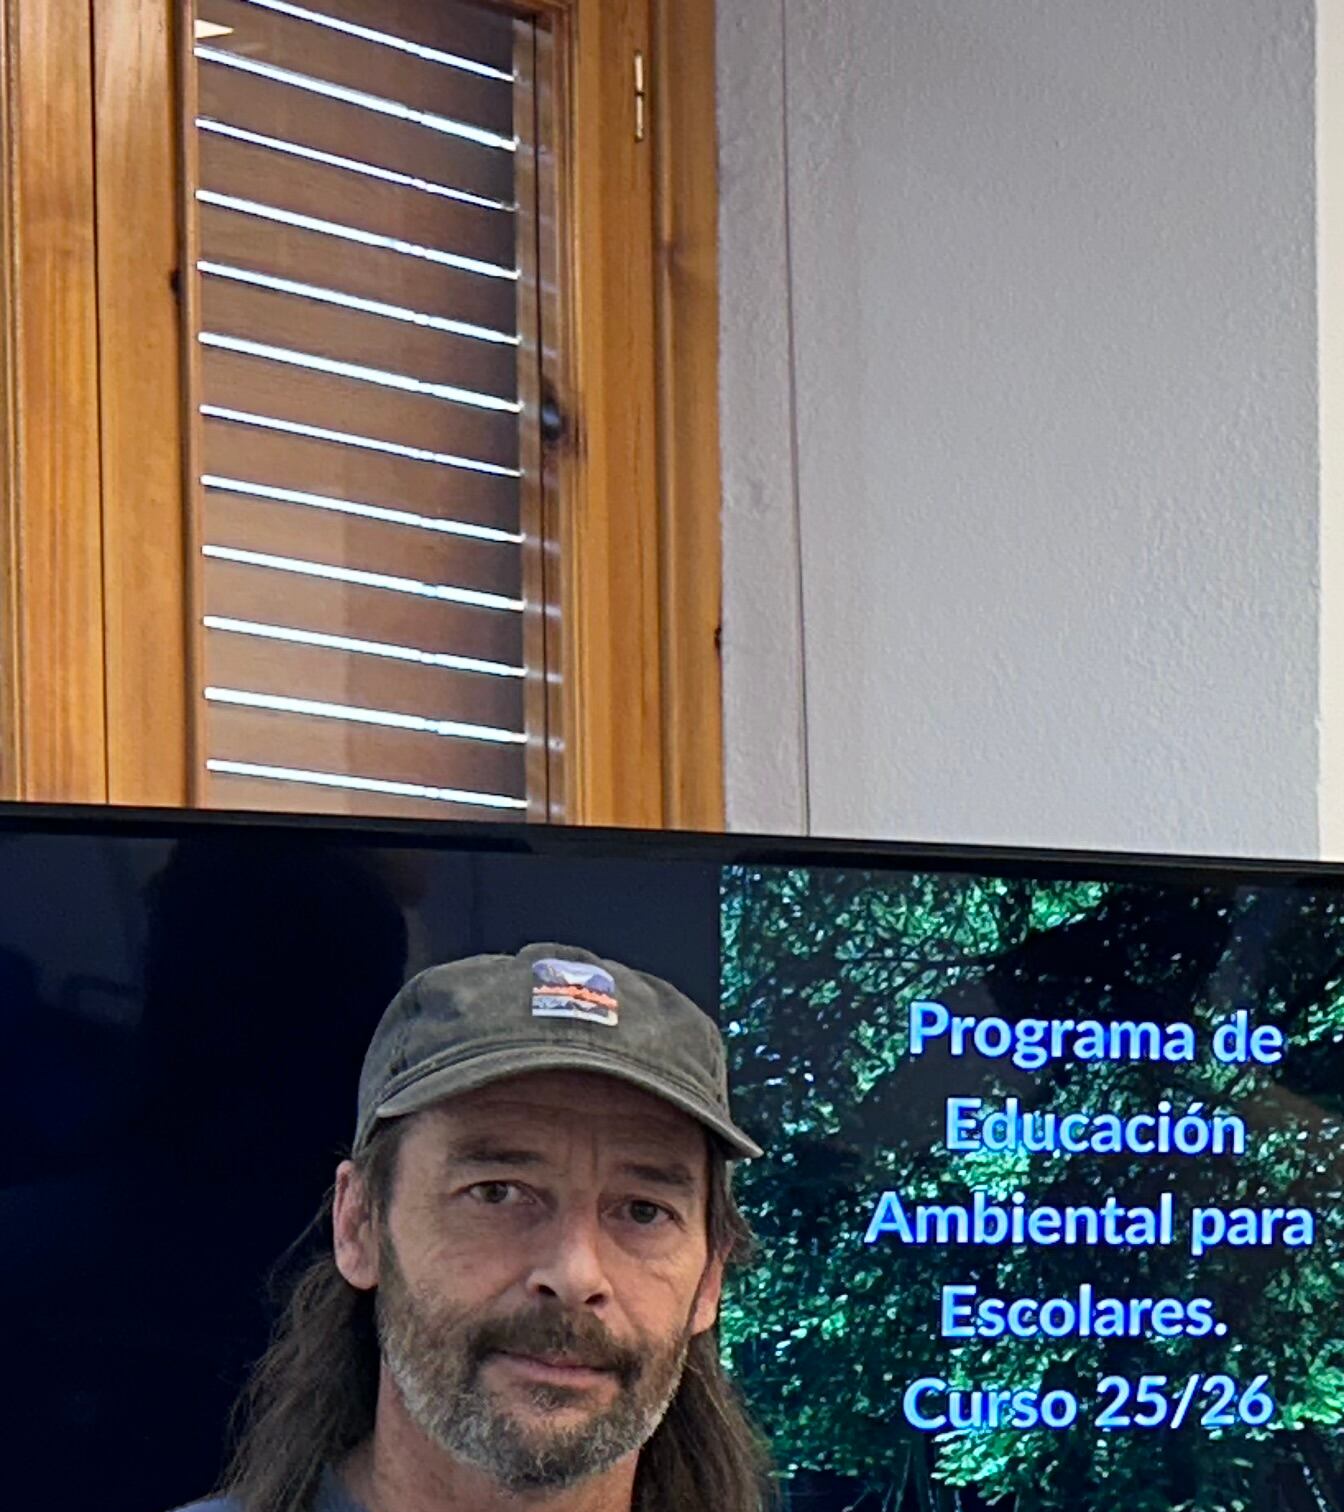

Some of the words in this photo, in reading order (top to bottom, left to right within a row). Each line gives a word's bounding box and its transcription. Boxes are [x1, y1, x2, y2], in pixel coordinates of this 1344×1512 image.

[908, 1001, 1195, 1069] Programa
[1211, 1010, 1284, 1064] de
[944, 1096, 1246, 1155] Educación
[864, 1191, 1173, 1247] Ambiental
[1190, 1207, 1315, 1256] para
[940, 1283, 1229, 1339] Escolares.
[902, 1377, 1077, 1430] Curso
[1094, 1374, 1275, 1431] 25/26
